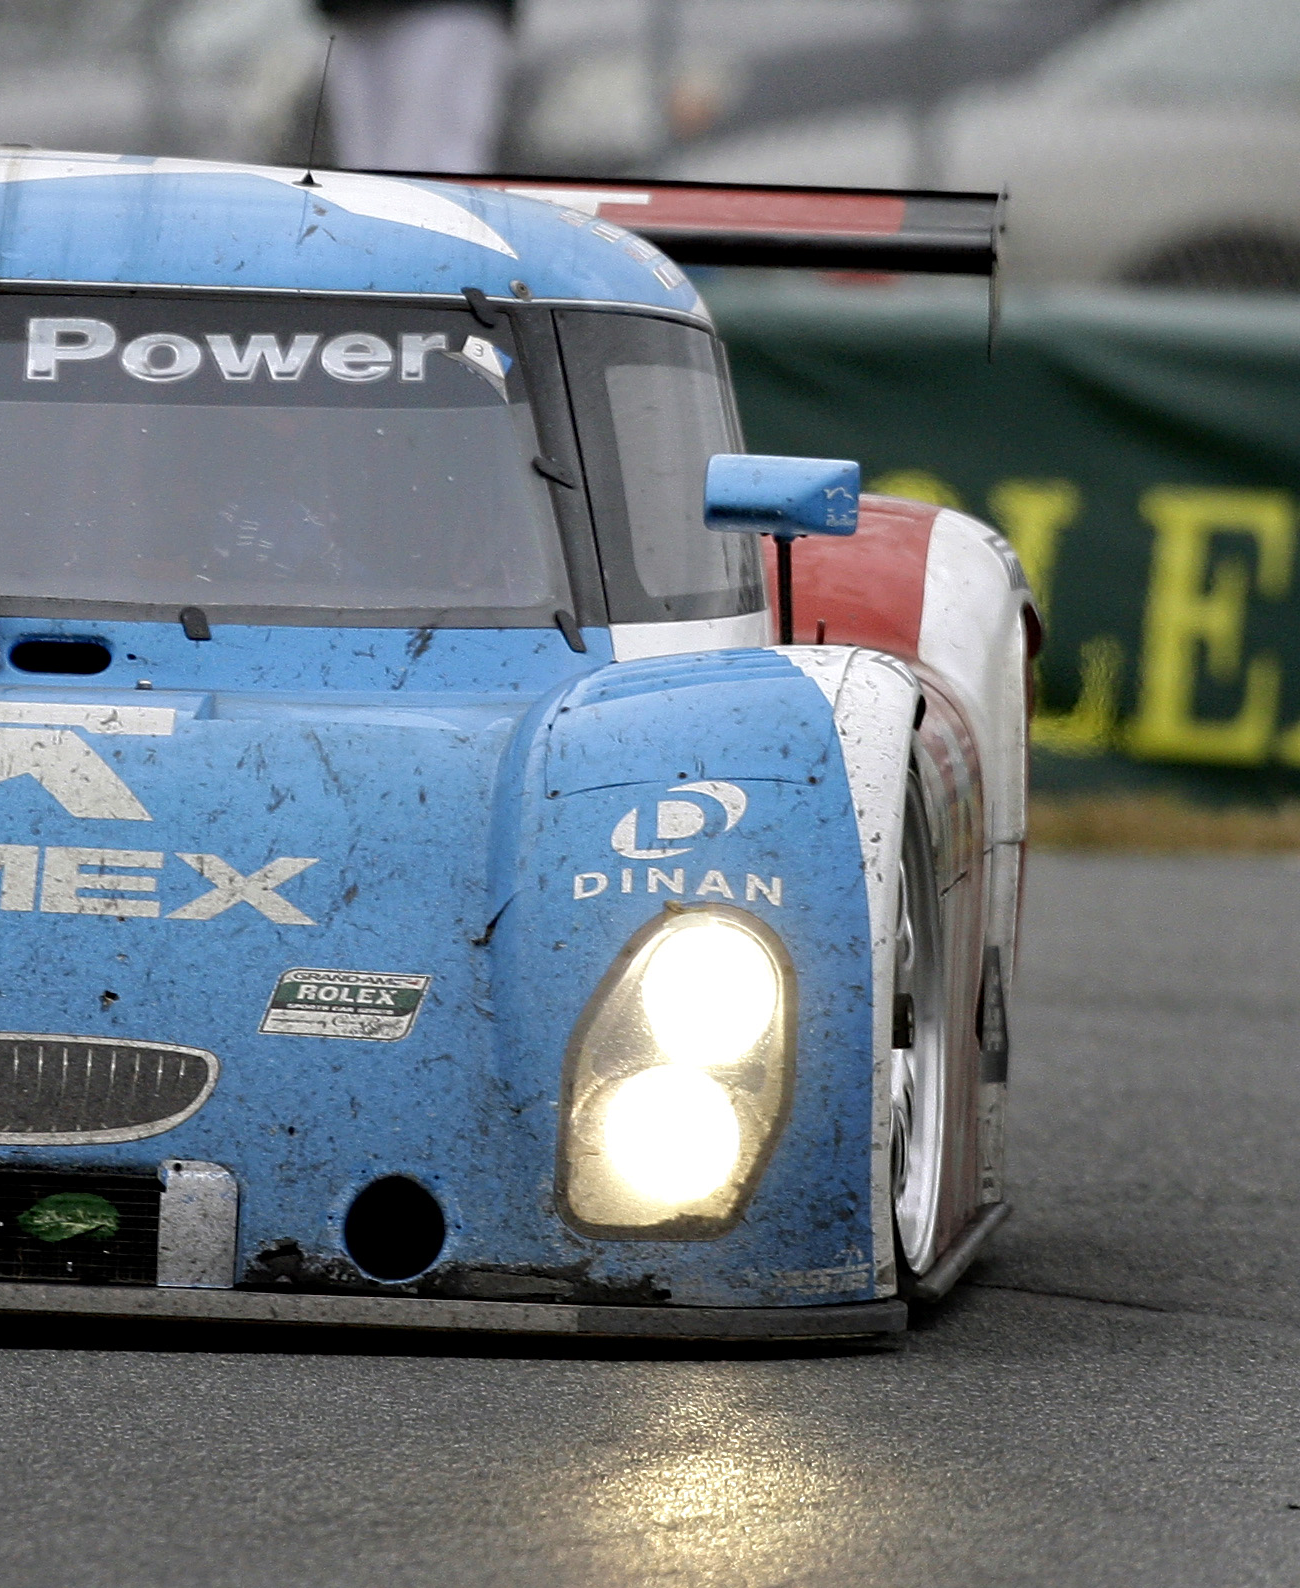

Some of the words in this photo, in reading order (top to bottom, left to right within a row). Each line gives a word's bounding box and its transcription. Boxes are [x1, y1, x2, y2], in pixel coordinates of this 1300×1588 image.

[24, 316, 447, 382] Power
[473, 343, 484, 358] 3
[572, 866, 784, 907] DINAN
[296, 984, 398, 1006] ROLEX
